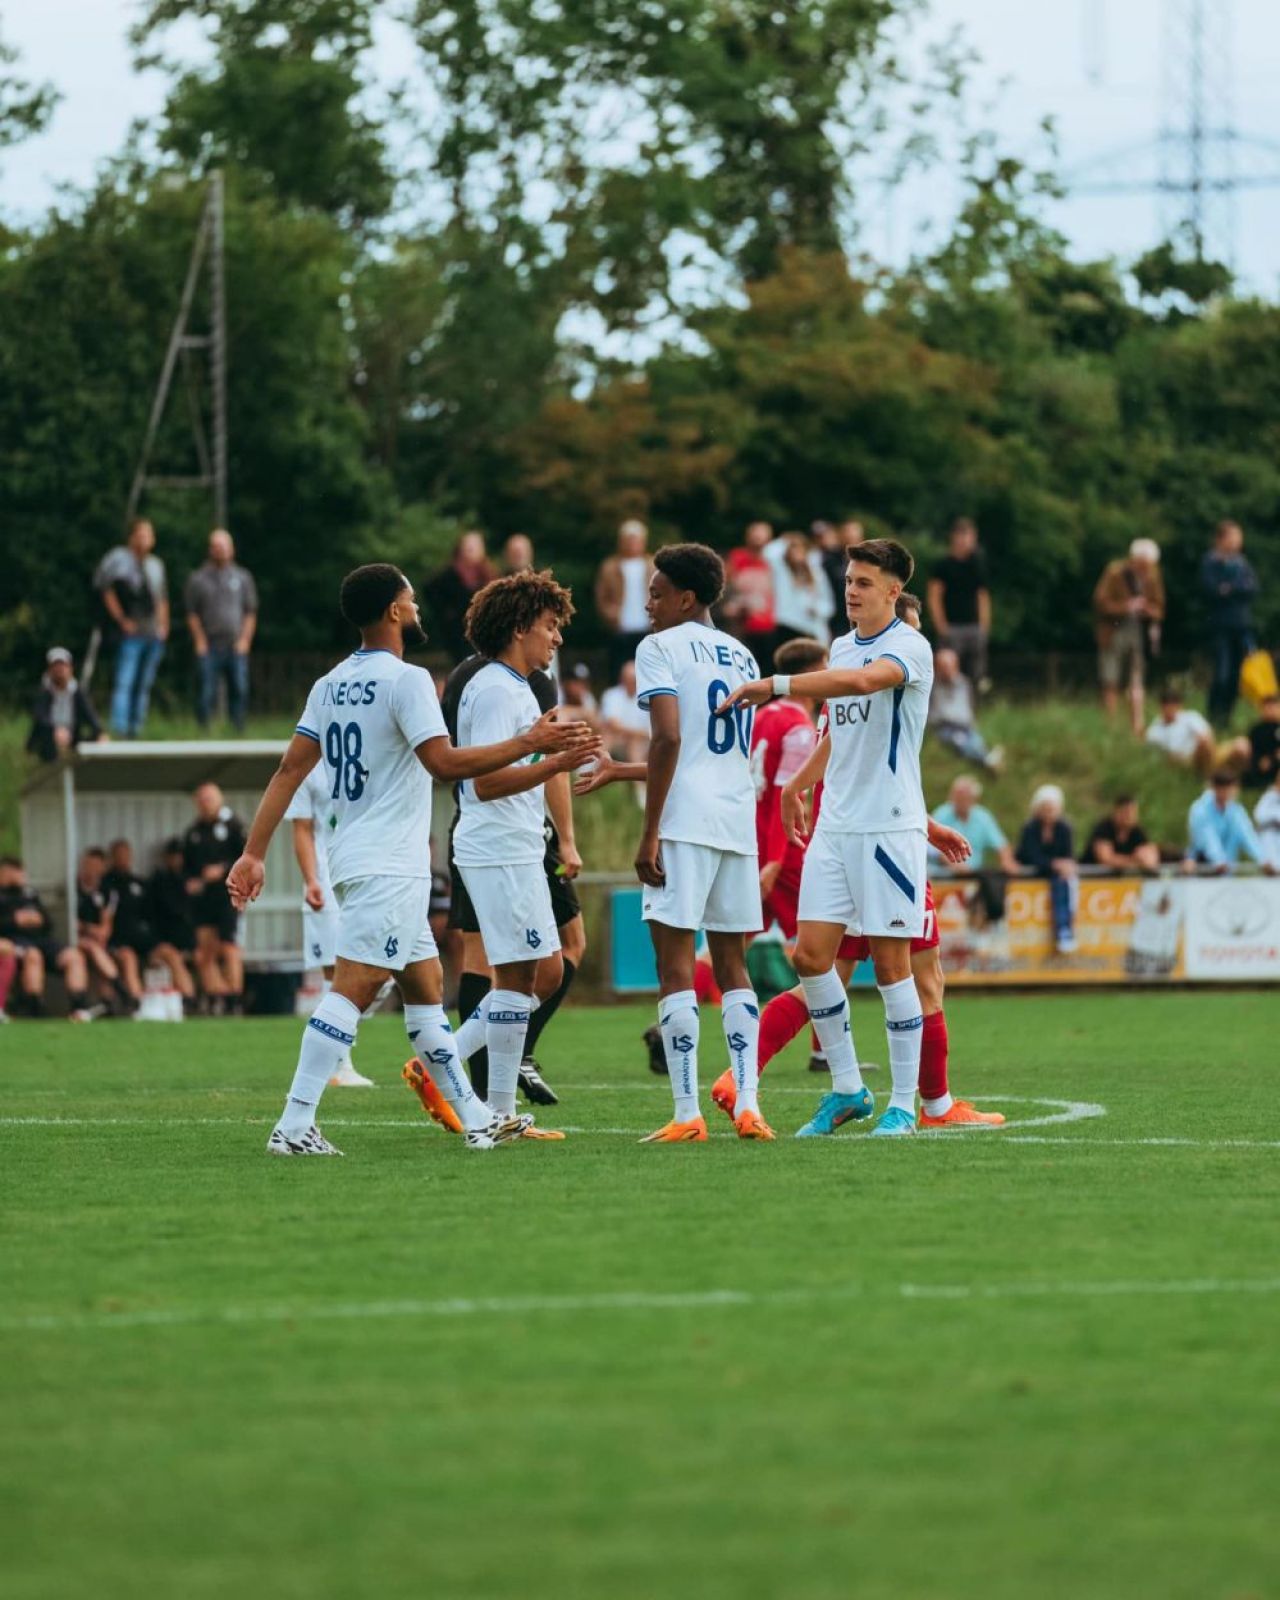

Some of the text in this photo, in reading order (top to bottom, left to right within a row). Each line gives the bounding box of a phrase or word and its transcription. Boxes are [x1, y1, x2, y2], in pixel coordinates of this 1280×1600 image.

[690, 640, 756, 680] INEOS
[835, 700, 872, 726] BCV
[326, 721, 365, 802] 98
